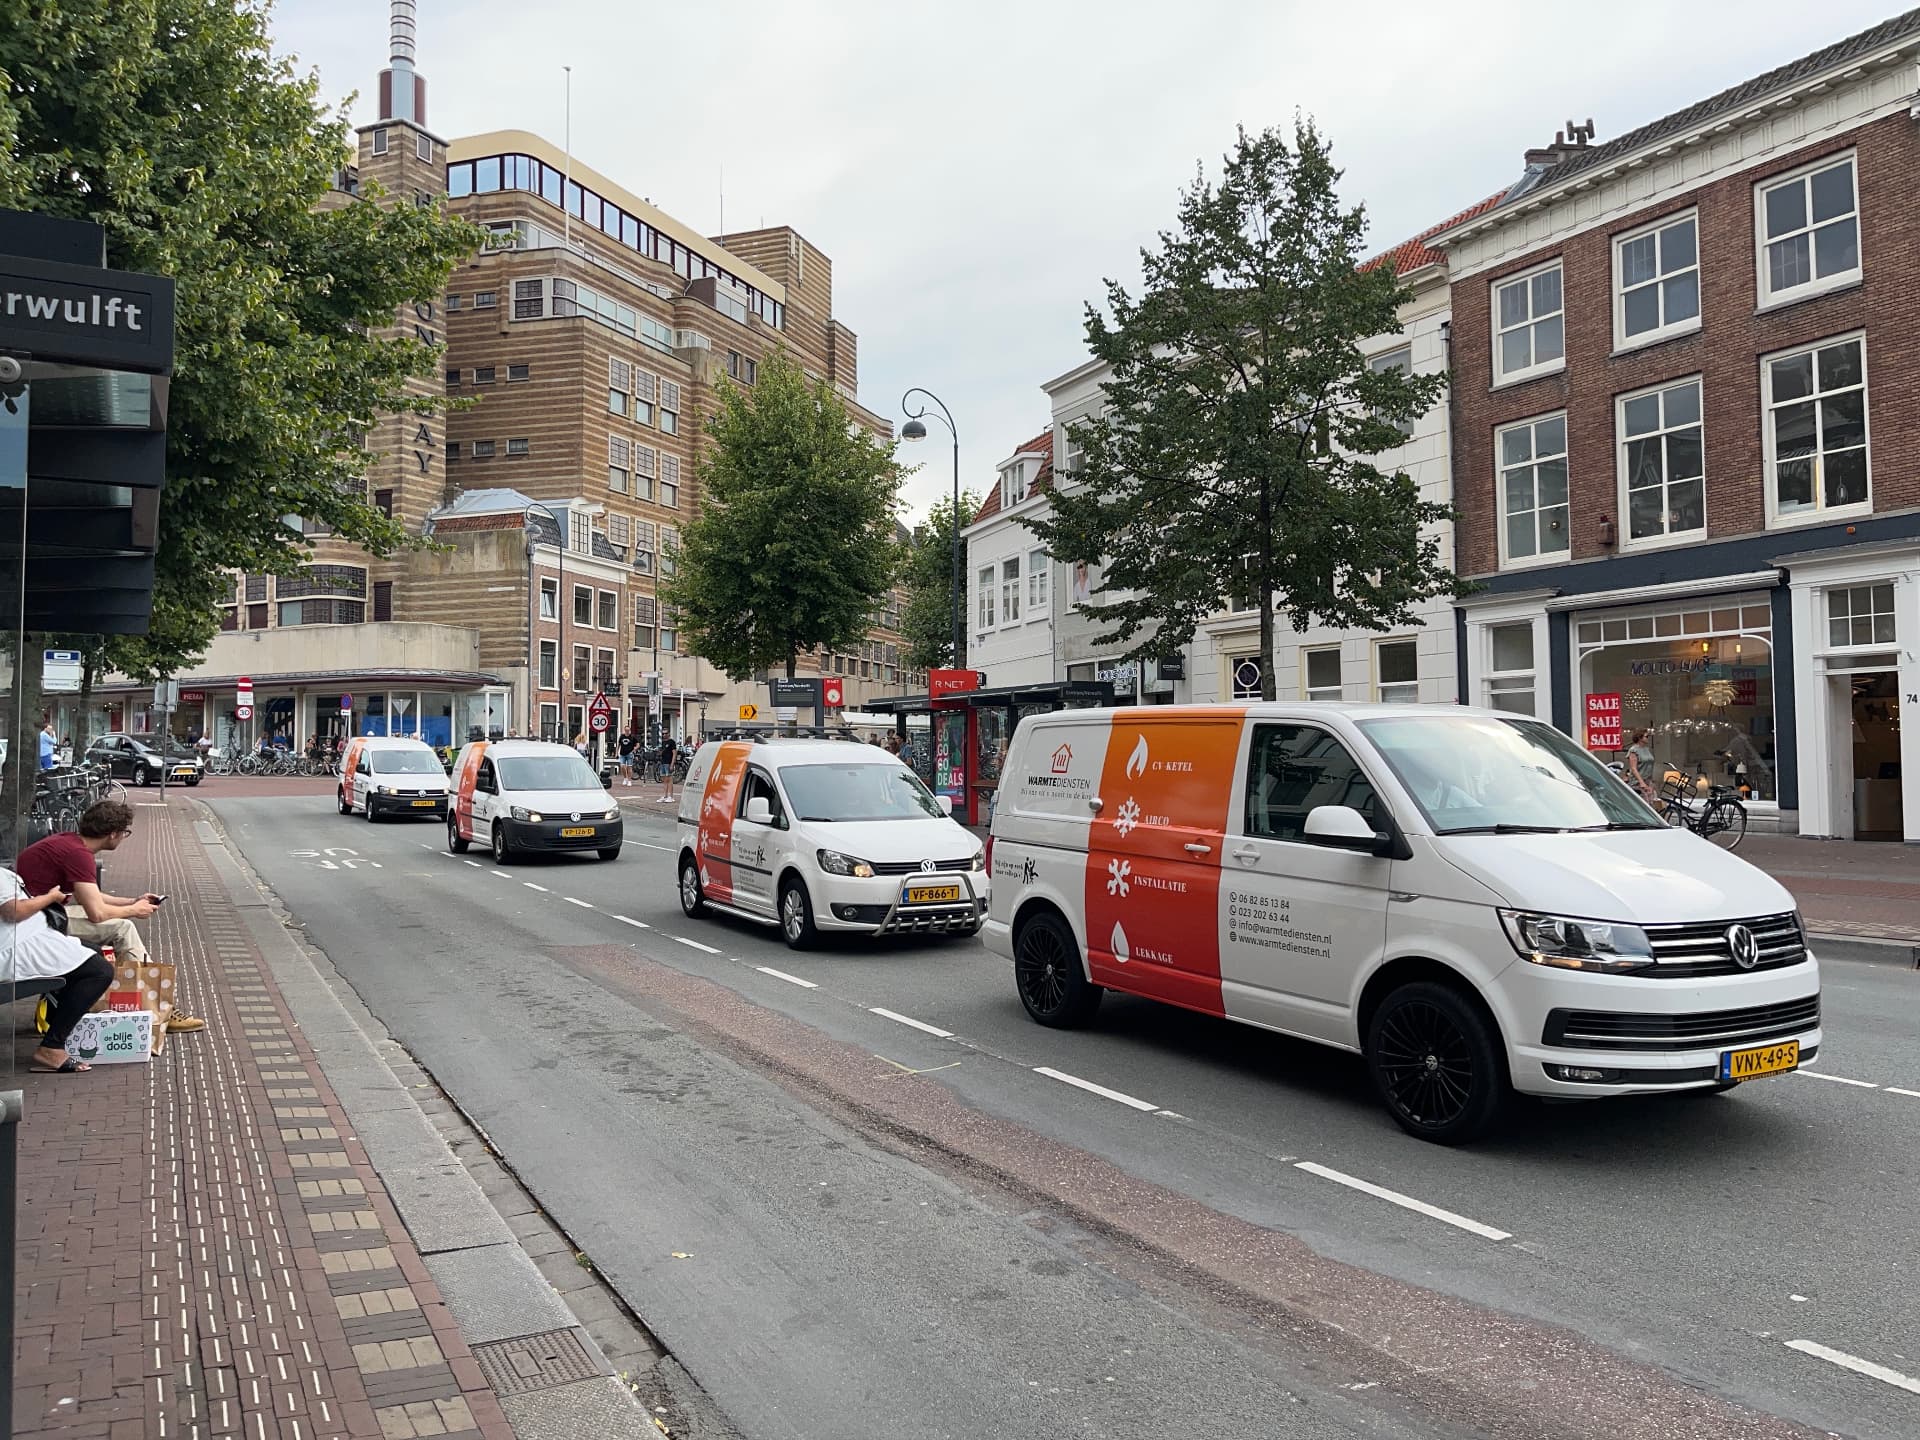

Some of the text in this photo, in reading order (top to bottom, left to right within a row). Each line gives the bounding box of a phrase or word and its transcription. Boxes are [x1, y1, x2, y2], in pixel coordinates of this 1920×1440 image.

[0, 292, 142, 331] rwulft
[1589, 698, 1619, 710] SALE
[1906, 694, 1918, 704] 74
[239, 708, 250, 716] 30
[593, 717, 607, 727] 30
[1590, 716, 1620, 728] SALE
[937, 728, 949, 742] GO
[1590, 734, 1621, 746] SALE
[937, 743, 949, 756] GO
[937, 772, 964, 787] DEALS
[1027, 775, 1091, 790] WARMTEDIENSTEN
[1145, 815, 1170, 826] AIRCO
[1134, 875, 1187, 893] INSTALLATIE
[912, 888, 956, 900] VF-866-T
[1239, 894, 1248, 904] 06
[1259, 897, 1269, 907] 85
[1270, 899, 1279, 908] 13
[1280, 900, 1290, 909] 84
[1238, 907, 1290, 924] 023 202 63 44
[1238, 920, 1332, 944] info@warmtediensten.nl
[1238, 934, 1331, 958] www.warmtediensten.nl
[1135, 946, 1174, 964] LEKKAGE
[110, 1003, 140, 1011] HEMA
[104, 1032, 133, 1044] de blije
[107, 1042, 133, 1050] doos
[1735, 1046, 1795, 1073] VNX-49-S
